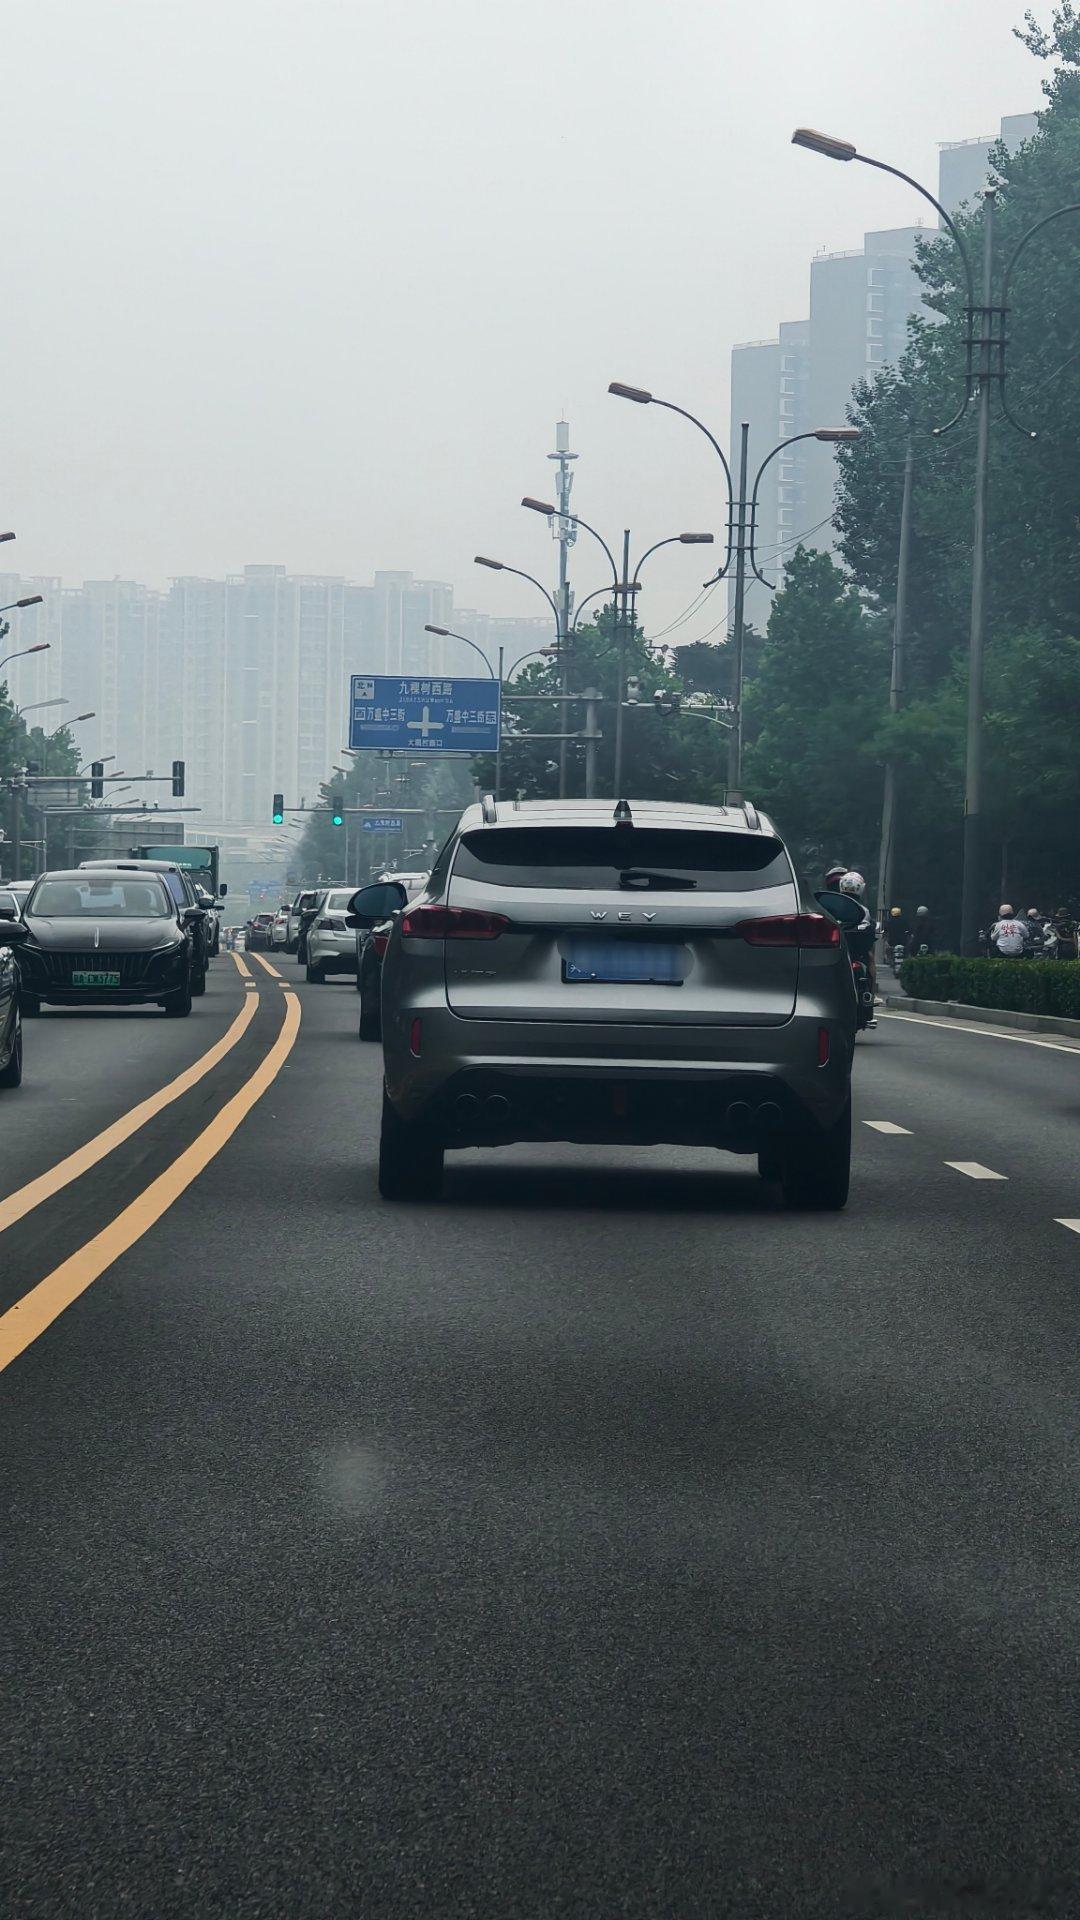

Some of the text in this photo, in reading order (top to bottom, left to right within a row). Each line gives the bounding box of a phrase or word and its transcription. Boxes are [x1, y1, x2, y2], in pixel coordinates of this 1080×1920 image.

[398, 681, 453, 696] 九棵树西路
[589, 910, 657, 922] WEY
